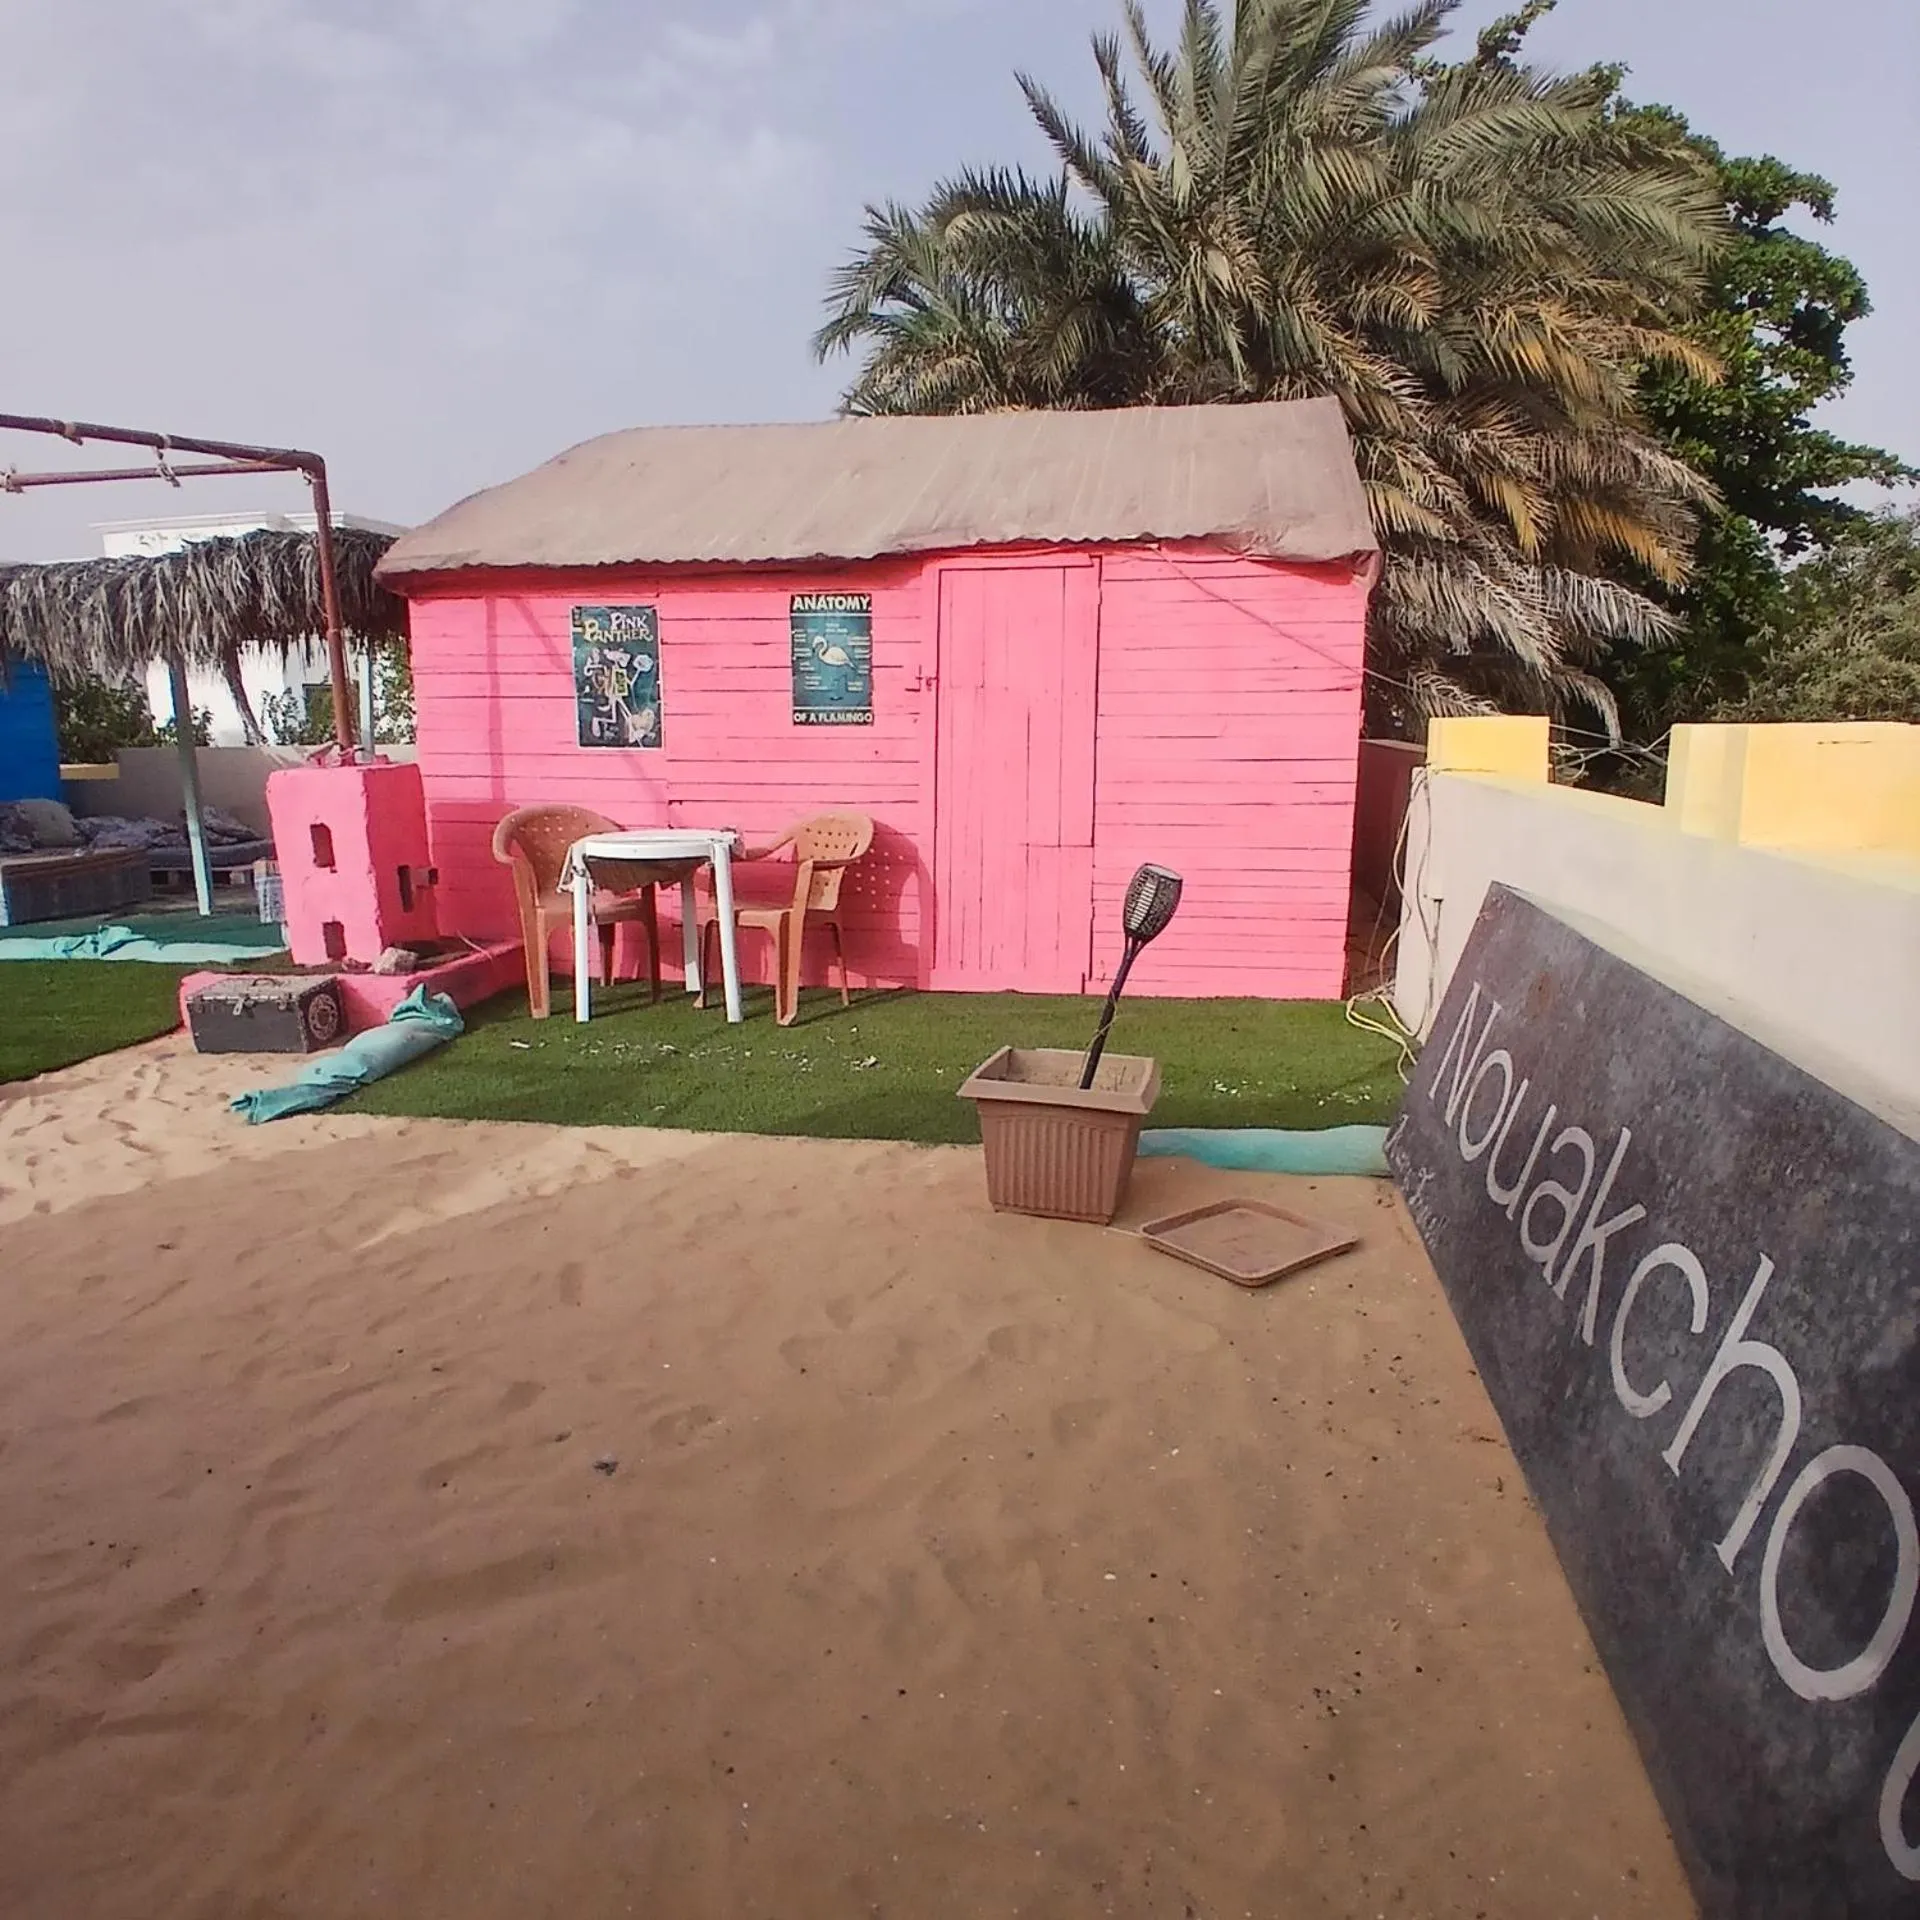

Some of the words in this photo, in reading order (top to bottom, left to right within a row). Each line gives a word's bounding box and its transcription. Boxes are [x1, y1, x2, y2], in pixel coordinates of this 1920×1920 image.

[793, 595, 869, 611] ANATOMY
[584, 618, 653, 643] PANTHER
[794, 712, 806, 723] OF
[809, 712, 817, 723] A
[818, 712, 873, 723] FLAMINGO
